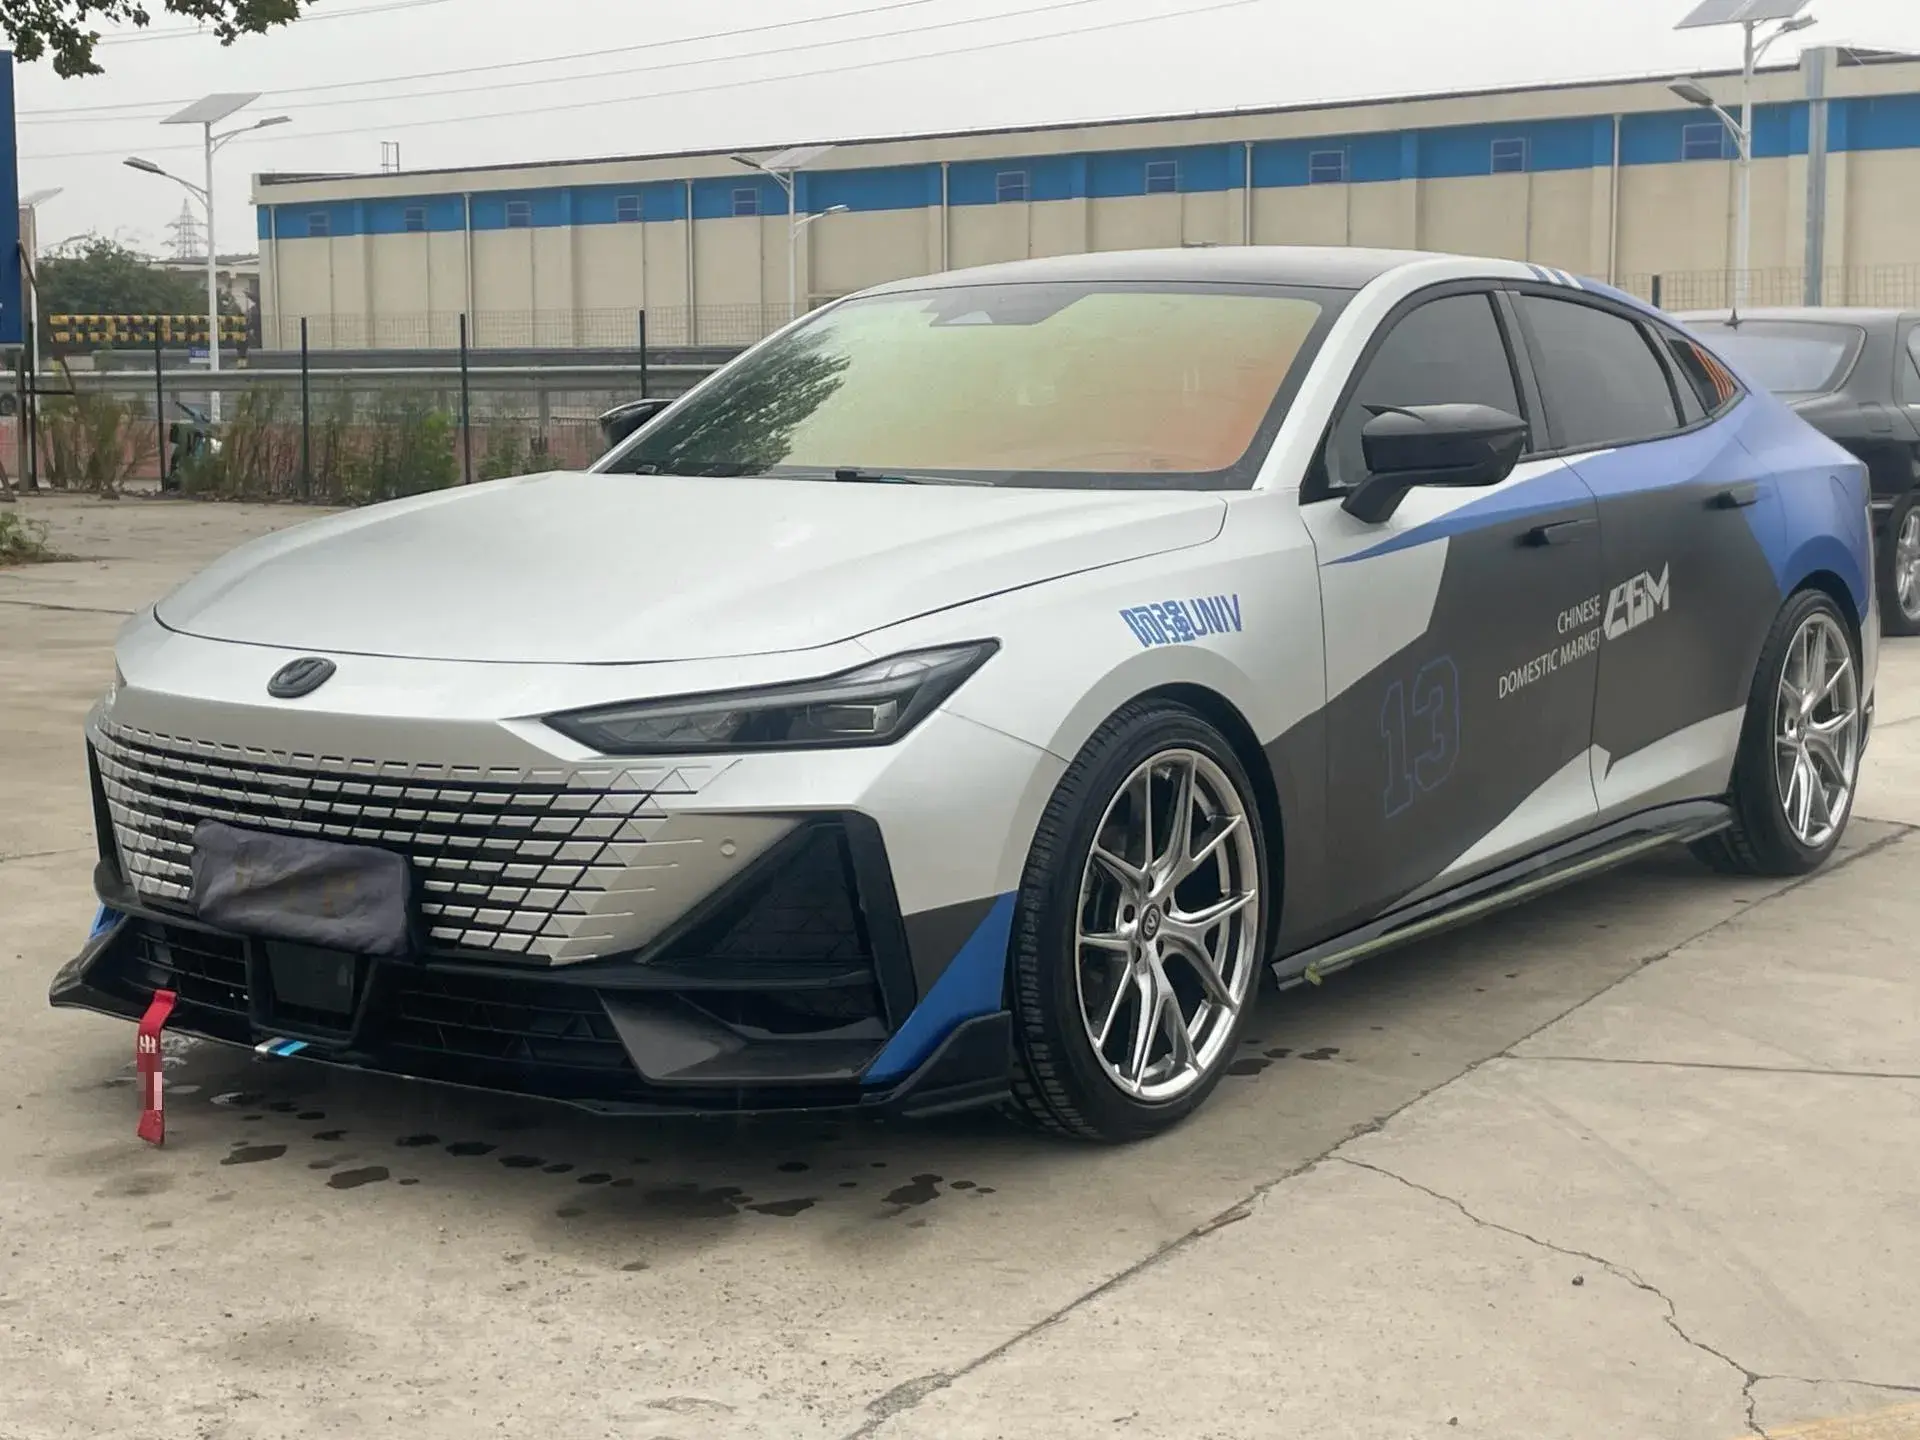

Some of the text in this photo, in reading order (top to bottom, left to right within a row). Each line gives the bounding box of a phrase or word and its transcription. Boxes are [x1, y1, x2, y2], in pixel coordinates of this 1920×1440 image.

[1557, 594, 1601, 635] CHINESE
[1499, 627, 1601, 700] DOMESTIC MARKET
[1380, 654, 1460, 819] 13
